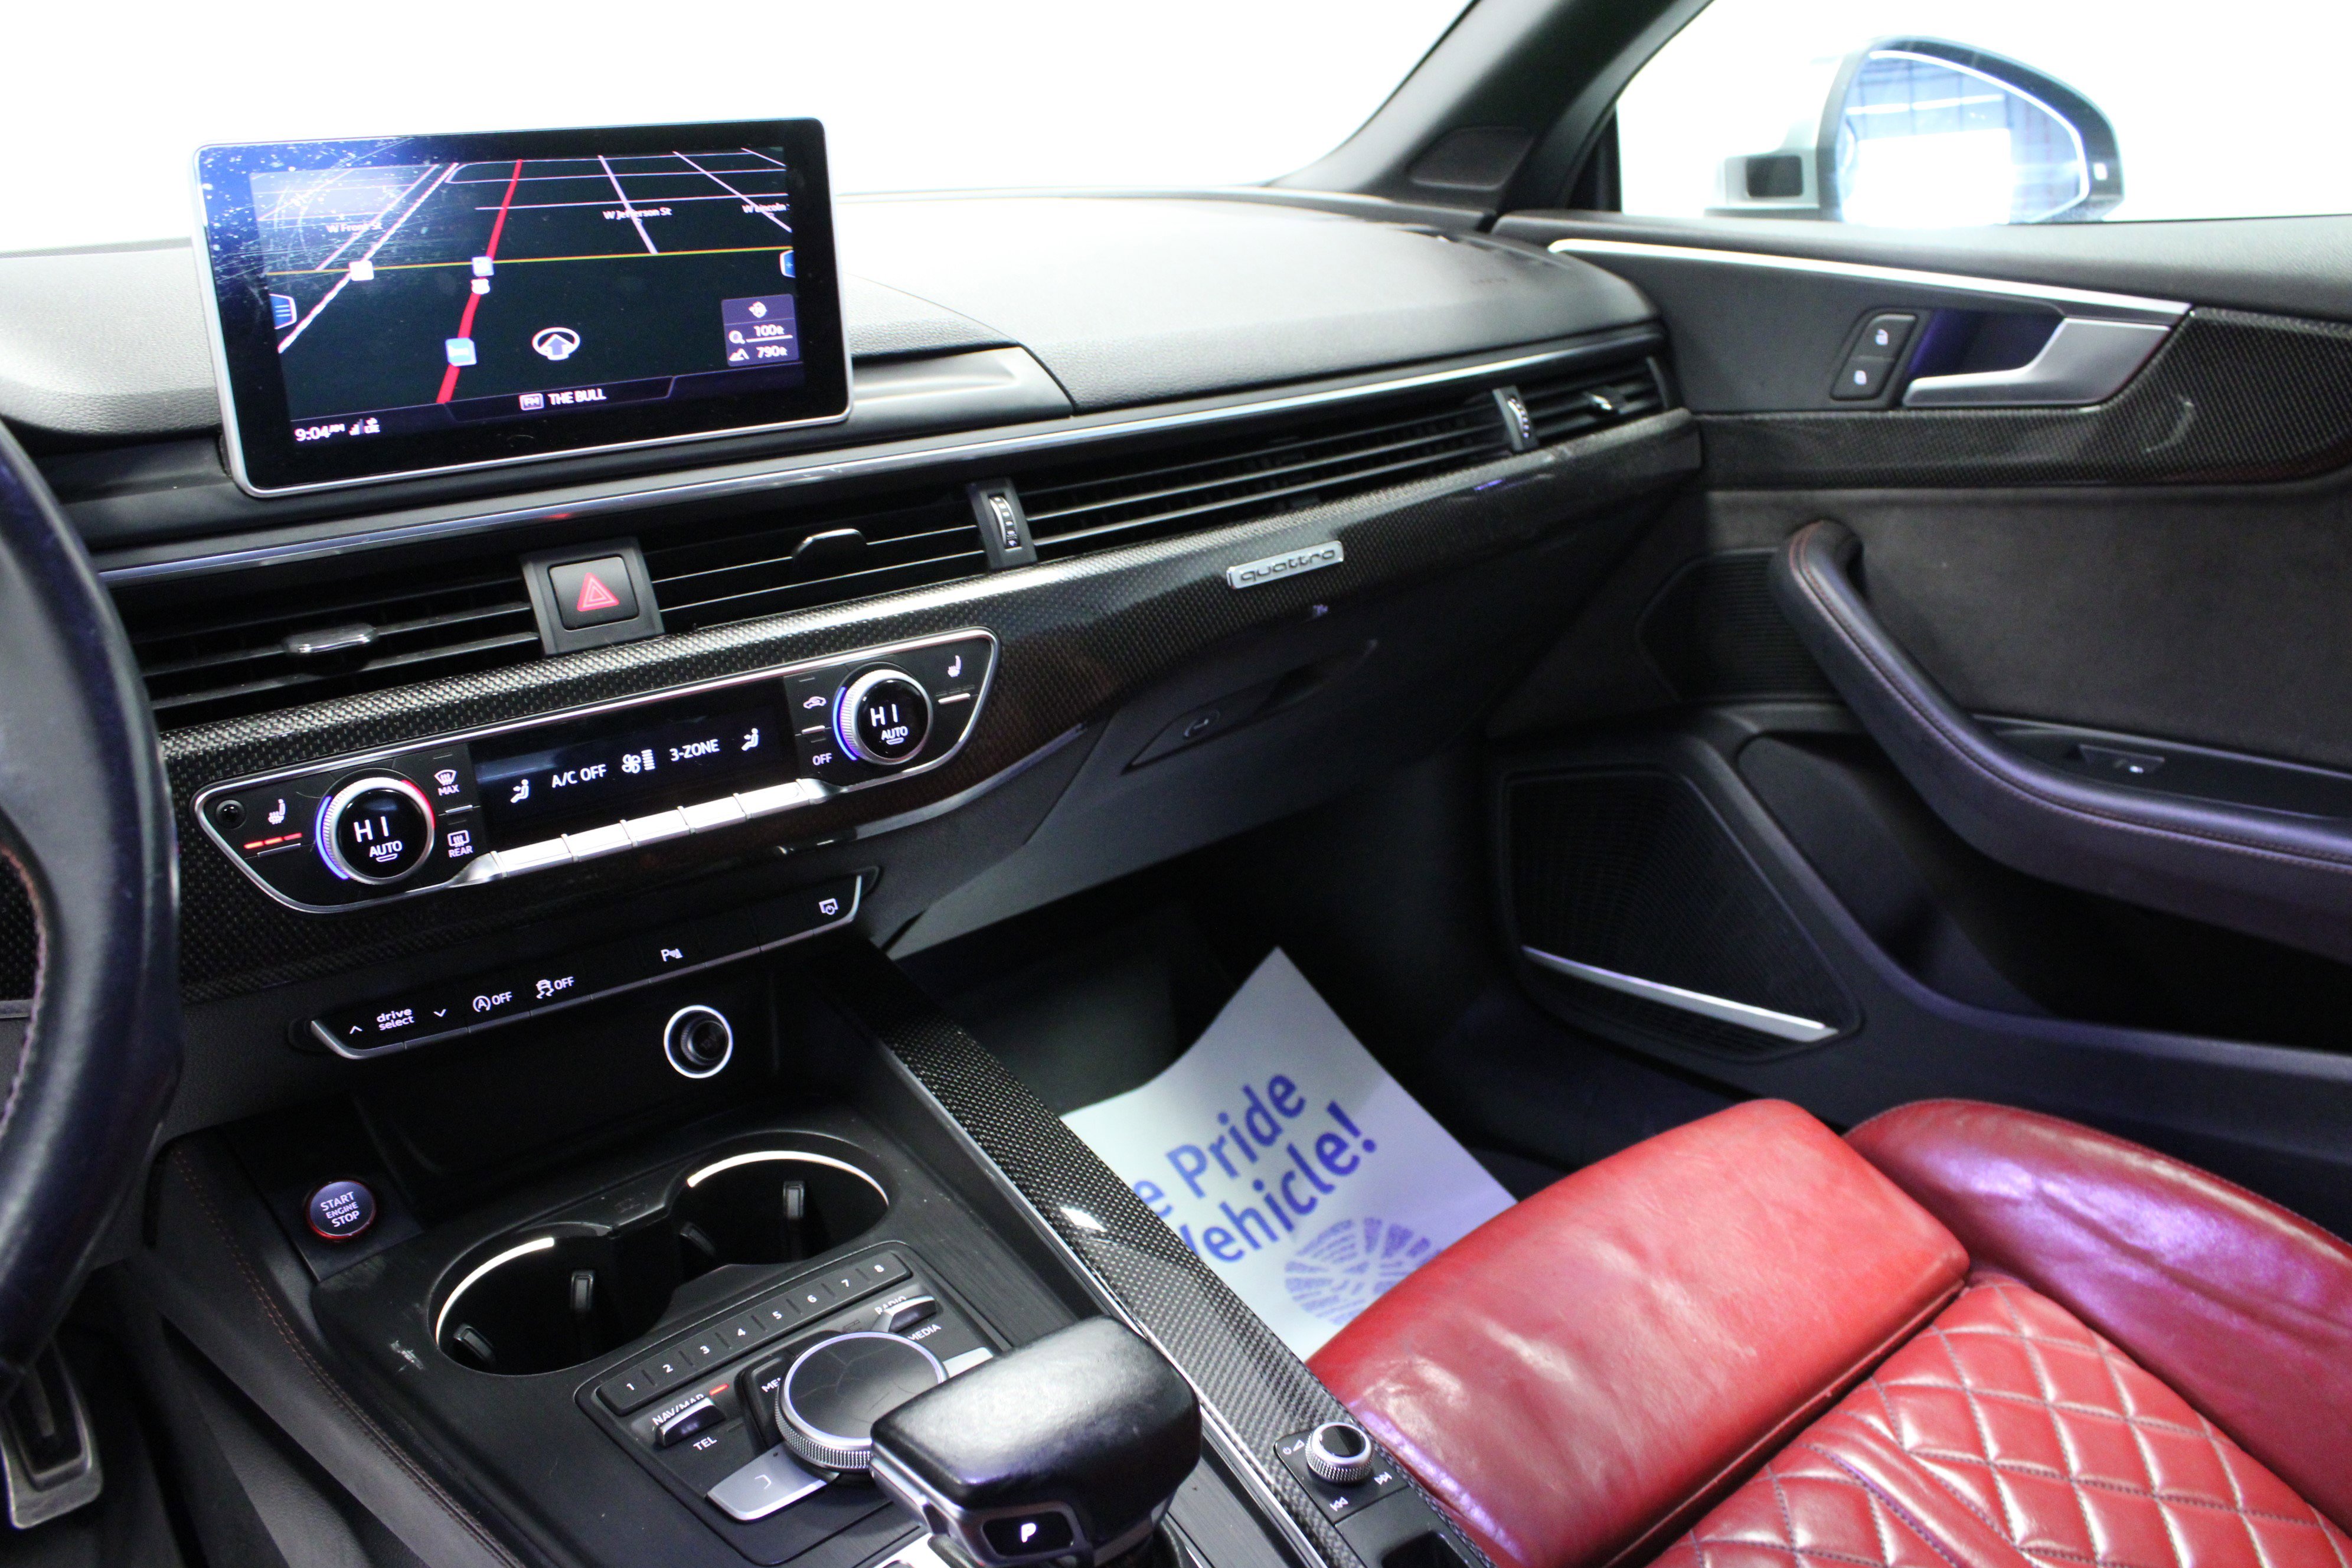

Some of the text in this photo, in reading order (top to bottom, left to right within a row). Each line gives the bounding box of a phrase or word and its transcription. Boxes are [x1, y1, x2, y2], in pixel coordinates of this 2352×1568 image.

[602, 210, 615, 220] W
[547, 391, 574, 406] THE
[574, 388, 607, 403] BULL
[1240, 550, 1335, 582] quattro
[881, 726, 909, 740] AUTO
[669, 739, 720, 762] 3-ZONE
[812, 753, 832, 766] OFF
[551, 764, 607, 788] A/C OFF
[437, 785, 460, 796] MAX
[369, 840, 403, 858] AUTO
[448, 845, 473, 858] REAR
[554, 976, 575, 991] OFF
[491, 991, 513, 1005] OFF
[376, 1008, 413, 1023] drive
[378, 1016, 414, 1031] select
[1165, 1073, 1307, 1199] Pride
[320, 1191, 354, 1211] START
[325, 1201, 359, 1219] ENGINE
[331, 1210, 360, 1227] STOP
[626, 1264, 884, 1391] 1 2 3 4 5 6 7 8
[907, 1324, 942, 1341] MEDIA
[692, 1436, 718, 1451] TEL
[1021, 1522, 1037, 1543] P
